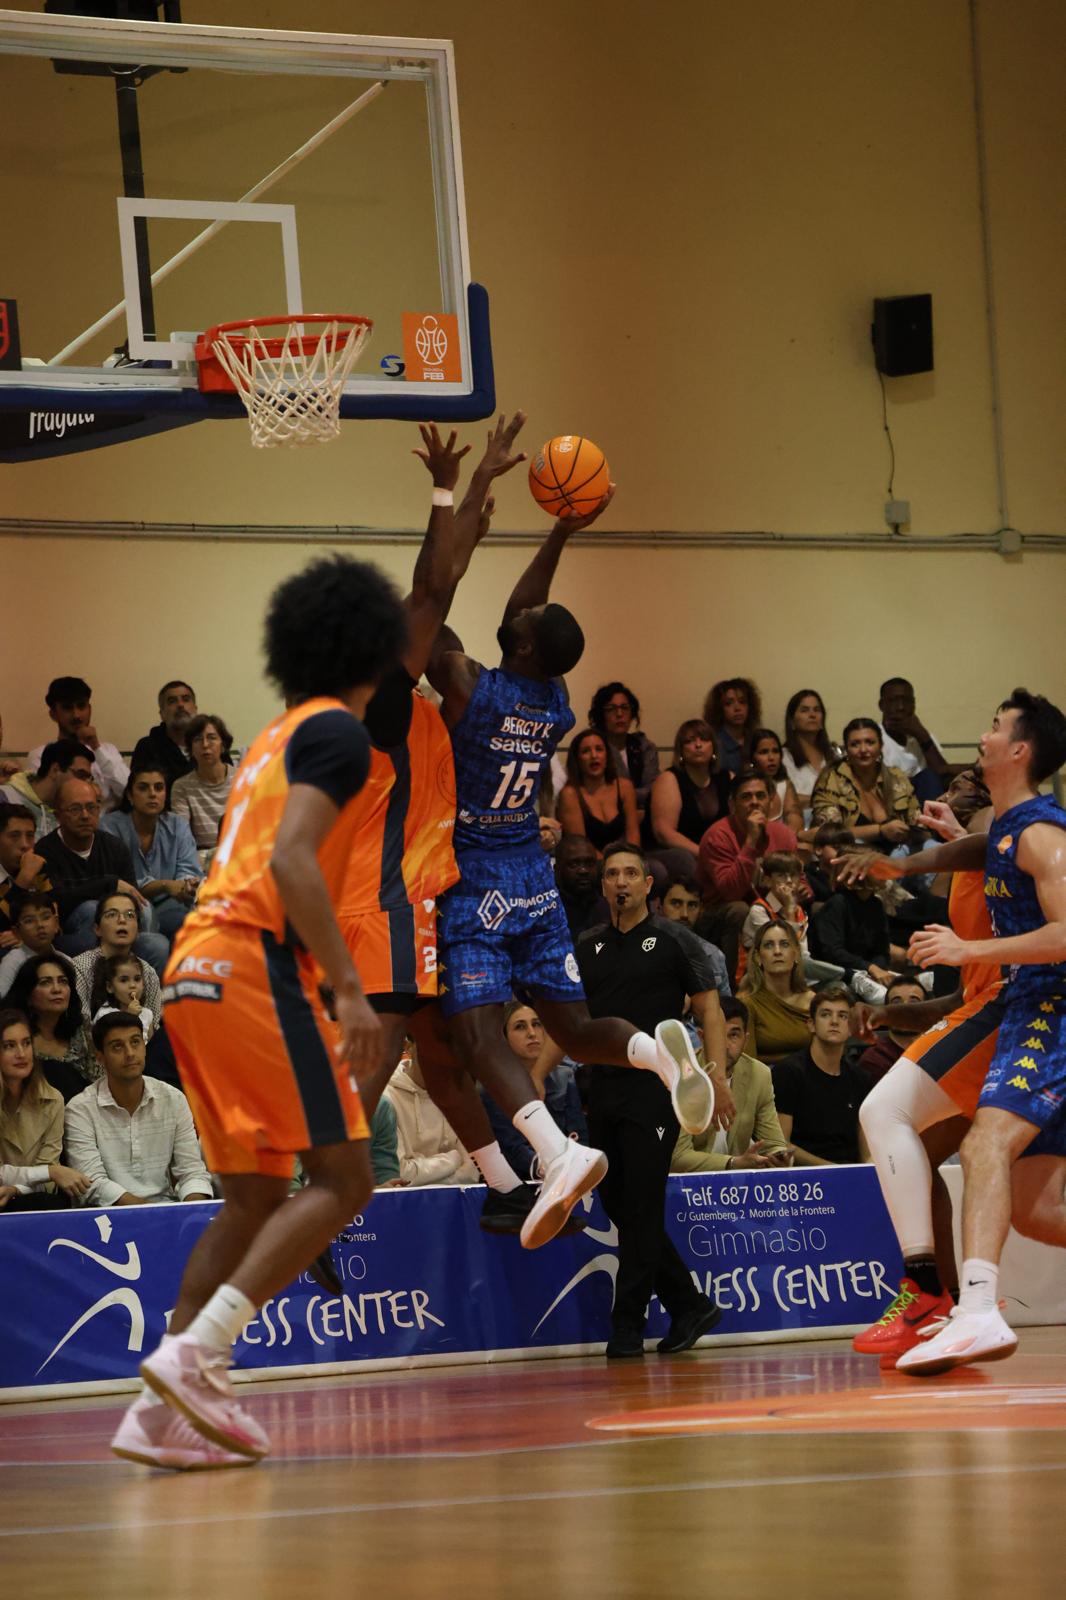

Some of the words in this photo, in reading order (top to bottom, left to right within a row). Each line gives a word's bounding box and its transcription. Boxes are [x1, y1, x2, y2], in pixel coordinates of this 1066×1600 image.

[424, 372, 444, 380] FEB
[490, 760, 540, 809] 15
[682, 1185, 717, 1207] Telf.
[720, 1186, 749, 1205] 687
[754, 1184, 775, 1204] 02
[779, 1183, 799, 1202] 88
[803, 1182, 823, 1201] 26
[676, 1211, 687, 1222] C/
[689, 1210, 738, 1222] Gutemberg,
[739, 1210, 746, 1219] 2
[749, 1207, 777, 1218] Morón
[778, 1207, 790, 1217] de
[791, 1206, 799, 1216] la
[800, 1206, 836, 1216] Frontera
[688, 1220, 827, 1257] Gimnasio
[772, 1261, 899, 1312] CENTER
[306, 1290, 445, 1345] CENTER
